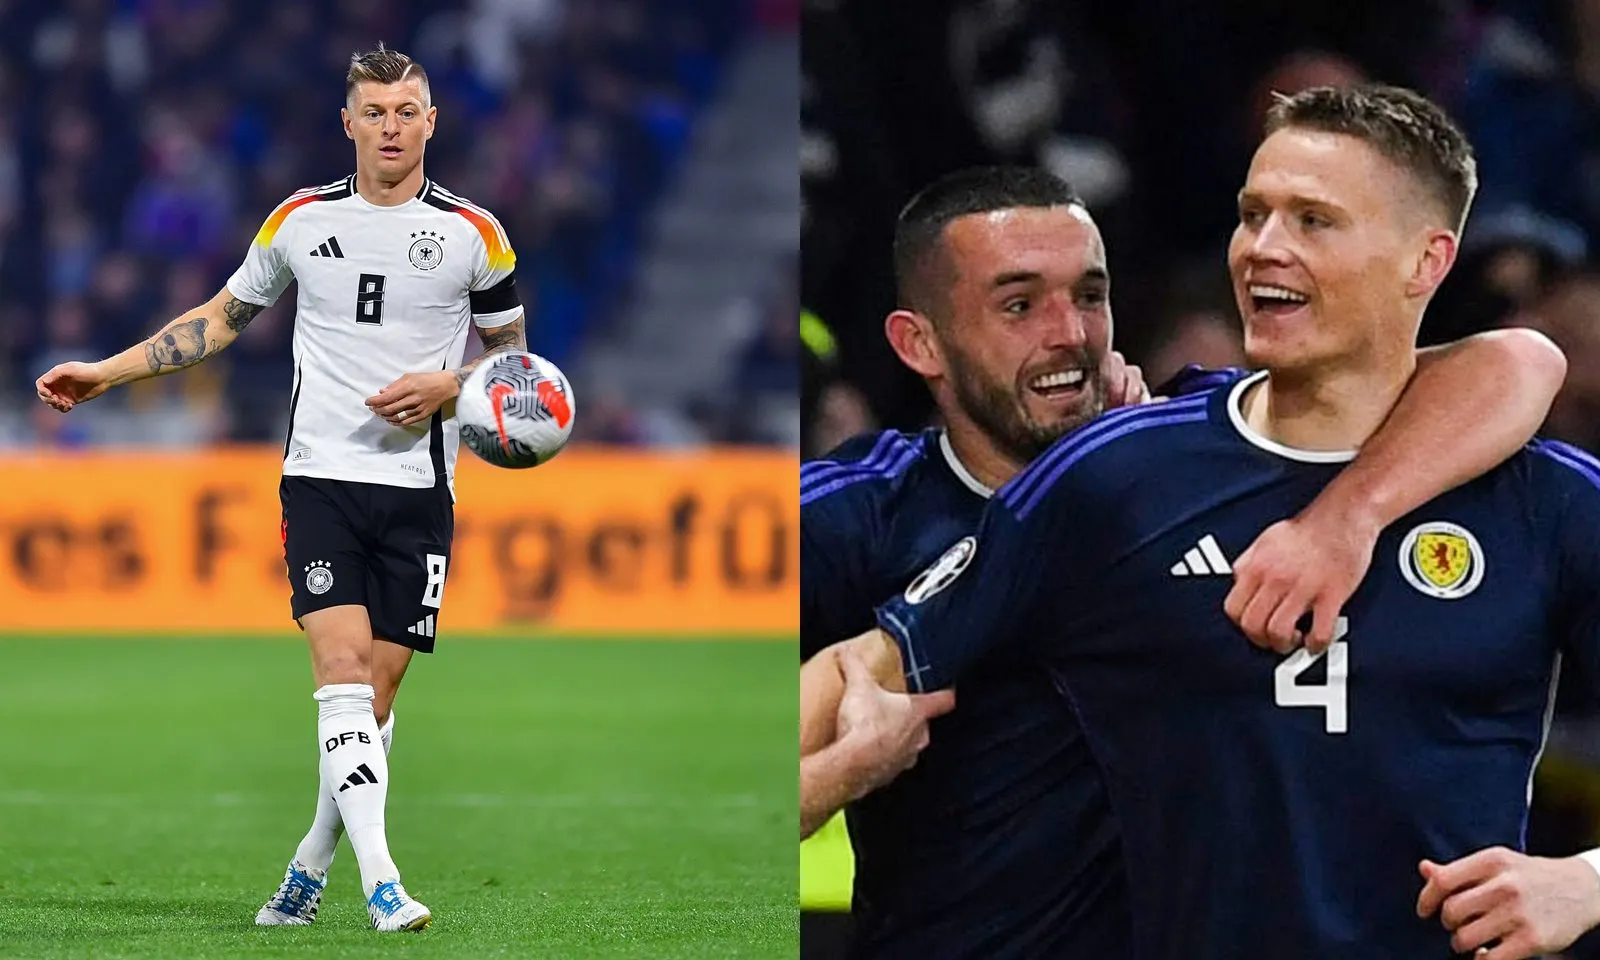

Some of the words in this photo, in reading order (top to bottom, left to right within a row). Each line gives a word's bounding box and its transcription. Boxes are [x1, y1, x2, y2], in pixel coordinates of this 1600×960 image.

[356, 273, 386, 326] 8
[0, 514, 148, 592] es
[421, 553, 447, 609] 8
[1274, 616, 1348, 733] 4
[325, 731, 371, 753] DFB
